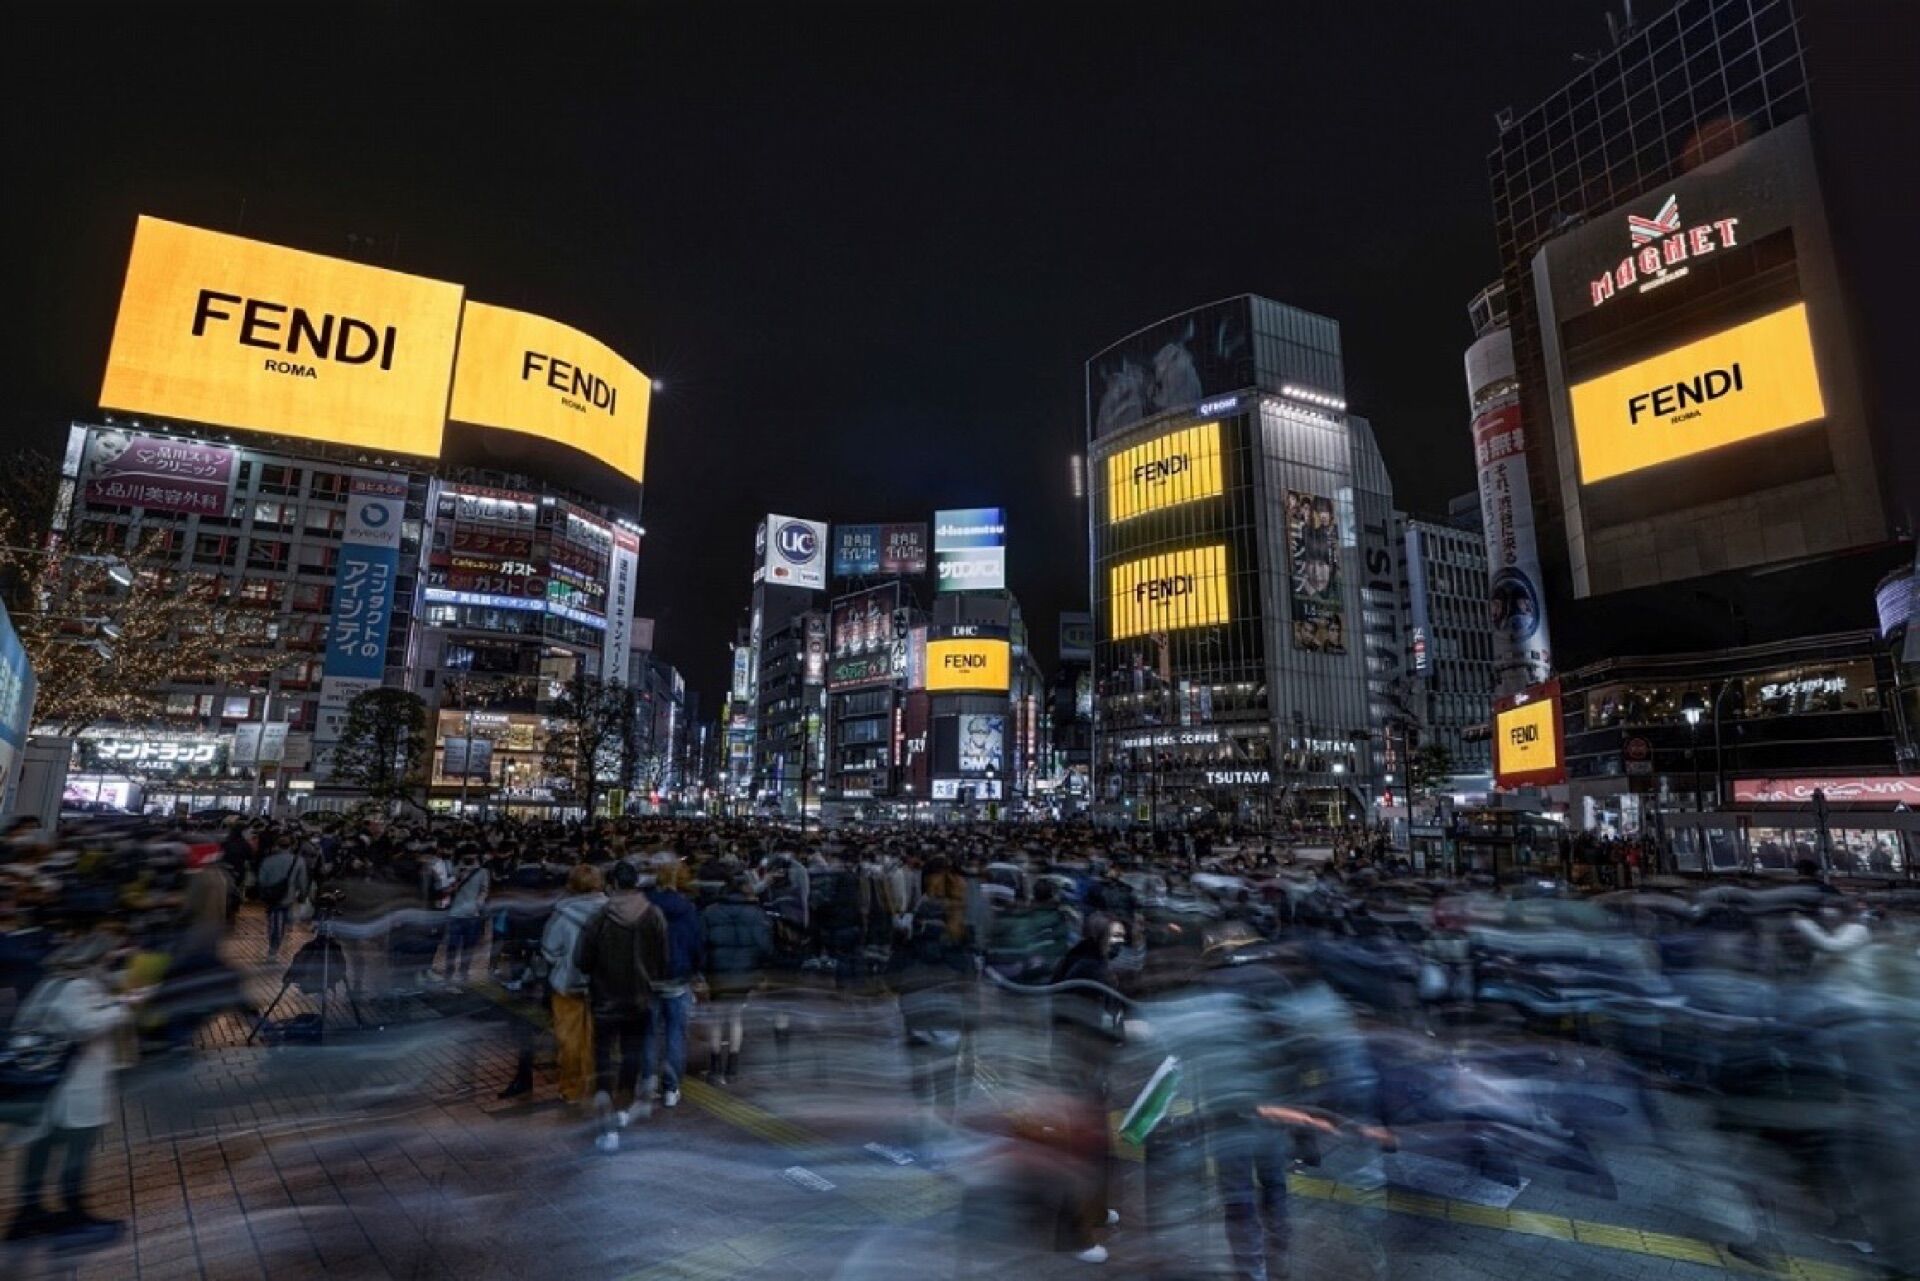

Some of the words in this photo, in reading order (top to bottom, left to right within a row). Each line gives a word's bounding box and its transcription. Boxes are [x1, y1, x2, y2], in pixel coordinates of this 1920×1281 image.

[1590, 218, 1739, 307] MAGNET
[191, 289, 397, 371] FENDI
[264, 358, 317, 379] ROMA
[521, 350, 617, 416] FENDI
[1628, 363, 1743, 425] FENDI
[561, 396, 587, 414] ROMA
[156, 460, 217, 476] クリニック
[1133, 453, 1189, 485] FENDI
[106, 482, 217, 510] 品川美容外科
[782, 530, 814, 554] UC
[500, 560, 537, 577] ガスト
[474, 575, 521, 595] ガスト
[1136, 573, 1193, 603] FENDI
[336, 560, 369, 655] アイシティ
[360, 562, 389, 658] コンタクトの
[951, 625, 978, 637] DHC
[944, 653, 987, 669] FENDI
[1510, 723, 1539, 746] FENDI
[96, 741, 217, 762] サンドラッグ
[1205, 771, 1270, 784] TSUTAYA
